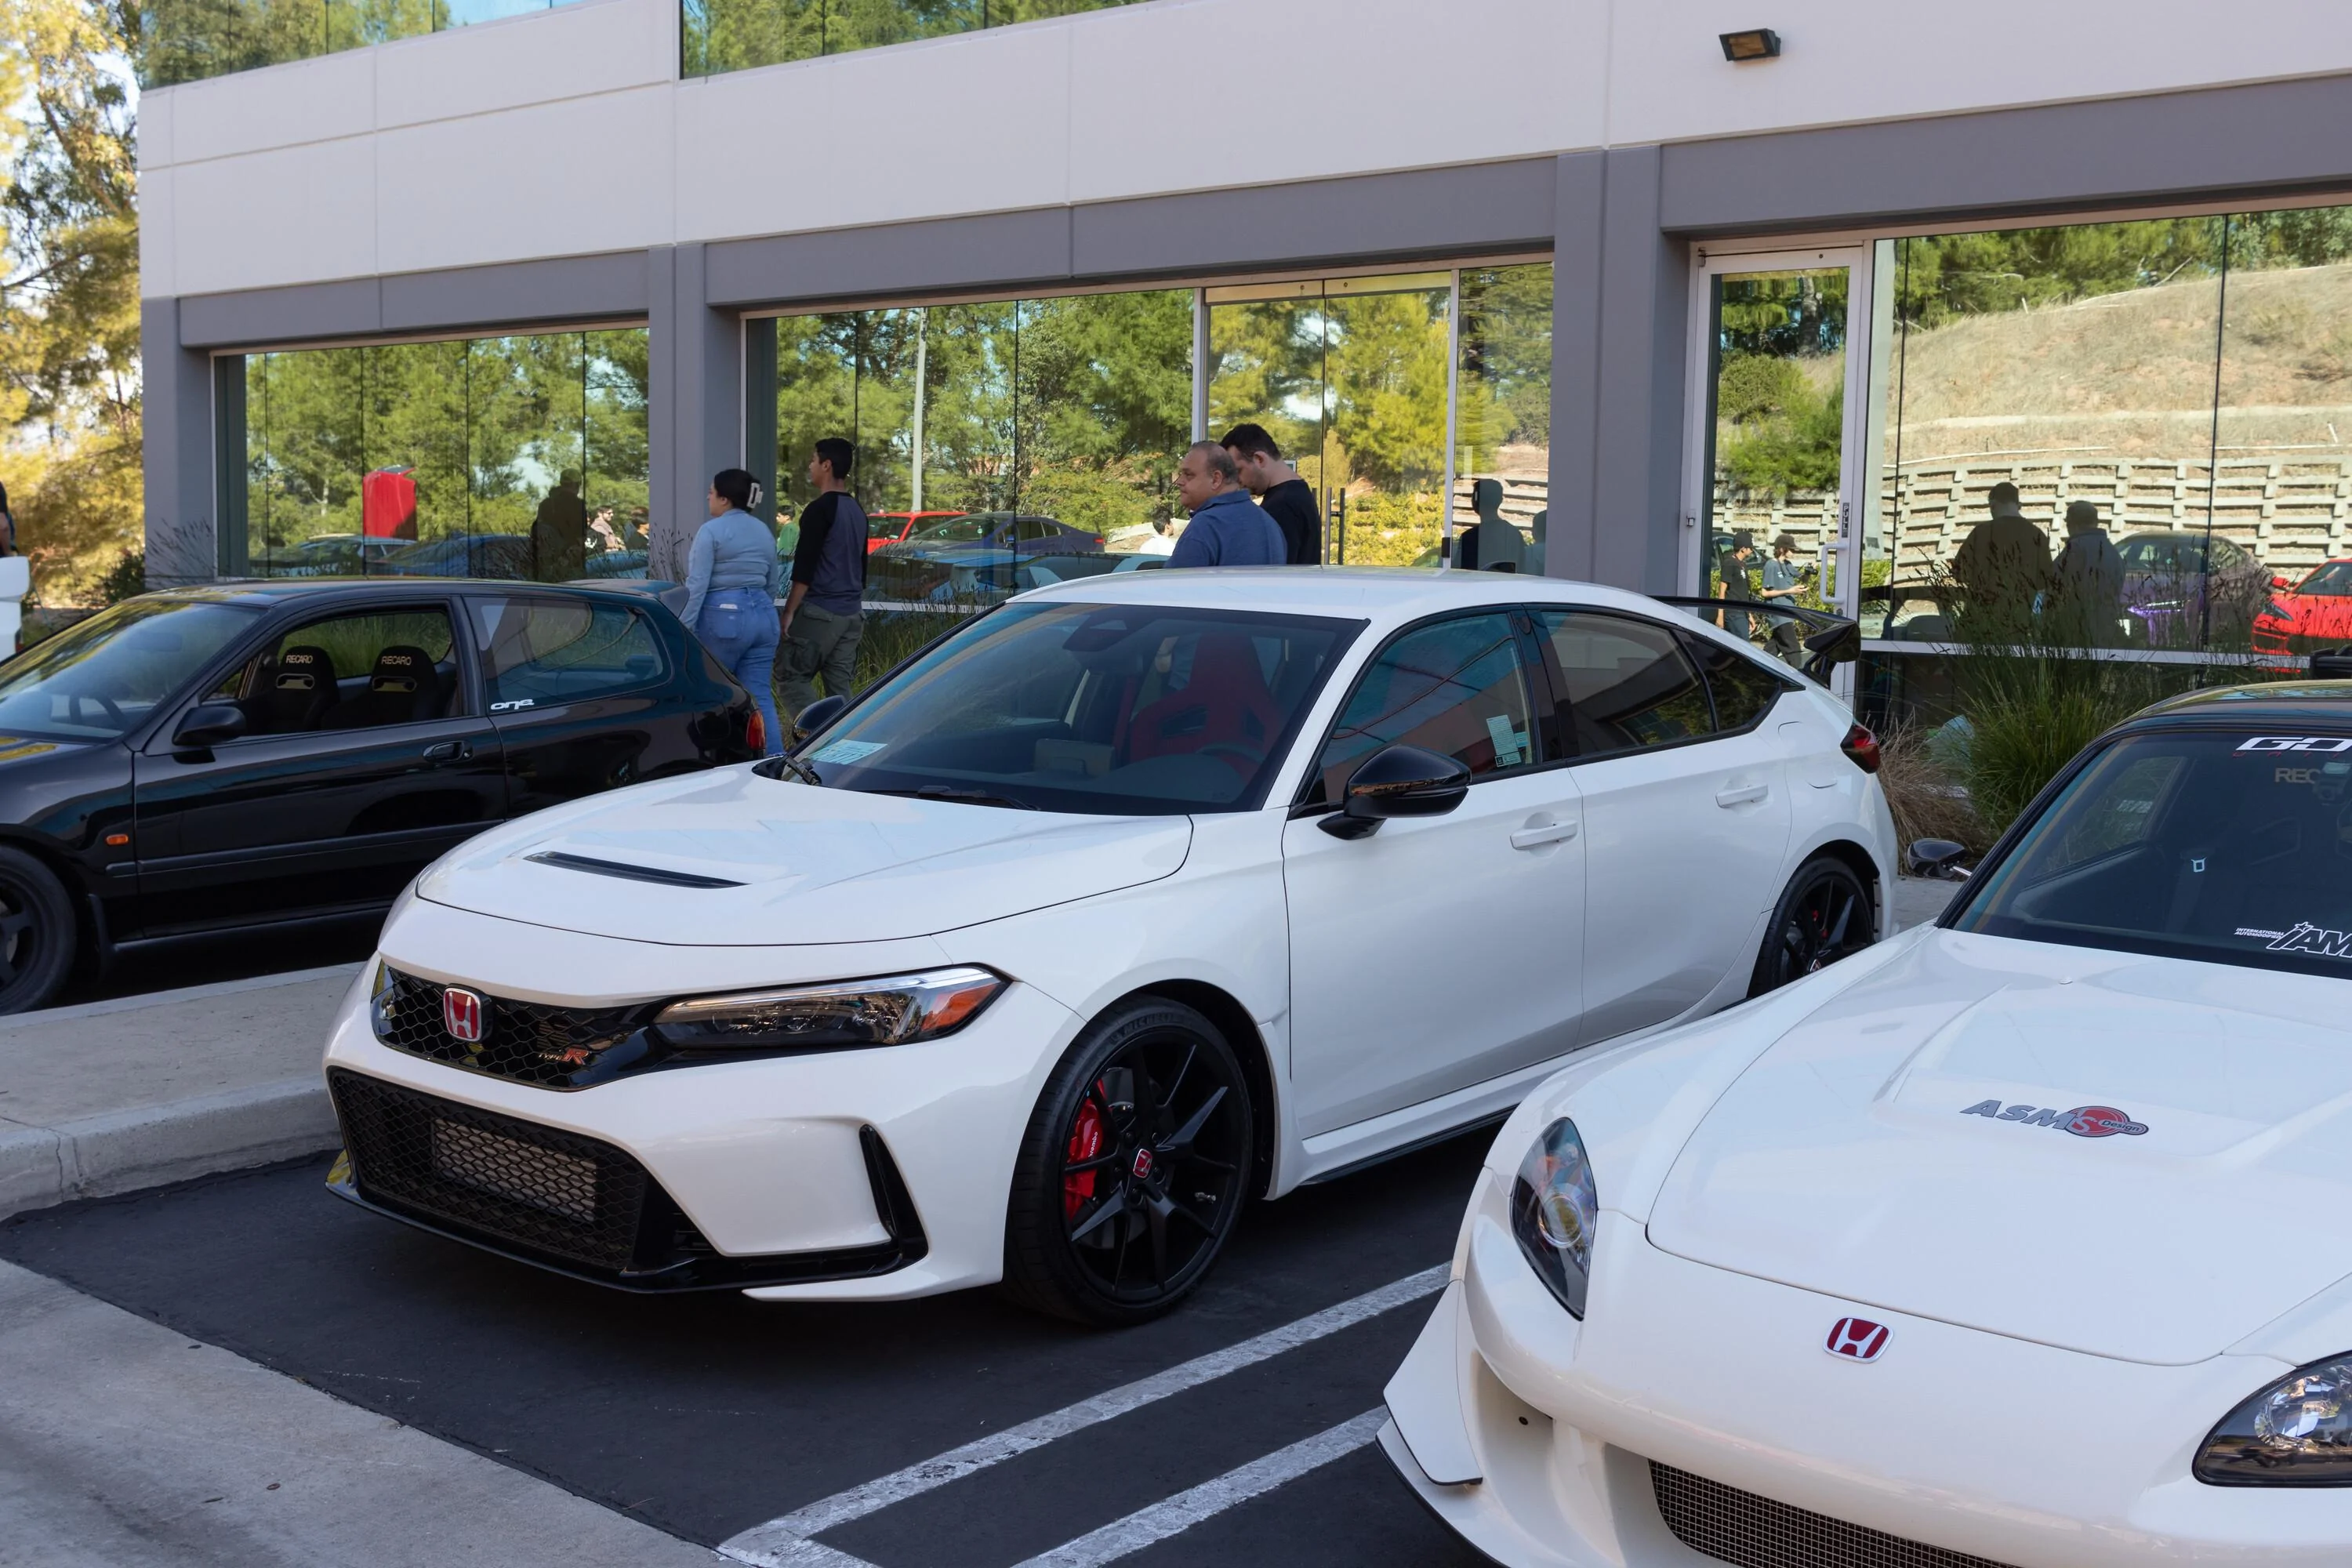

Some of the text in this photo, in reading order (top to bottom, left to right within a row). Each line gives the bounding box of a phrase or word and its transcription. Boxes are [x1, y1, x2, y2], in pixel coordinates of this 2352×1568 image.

[285, 655, 314, 664] RECARO
[381, 655, 412, 666] RECARO
[2274, 768, 2321, 784] REC
[2235, 927, 2285, 936] INTERNATIONAL
[1959, 1099, 2077, 1130] ASM
[2101, 1120, 2140, 1131] Design
